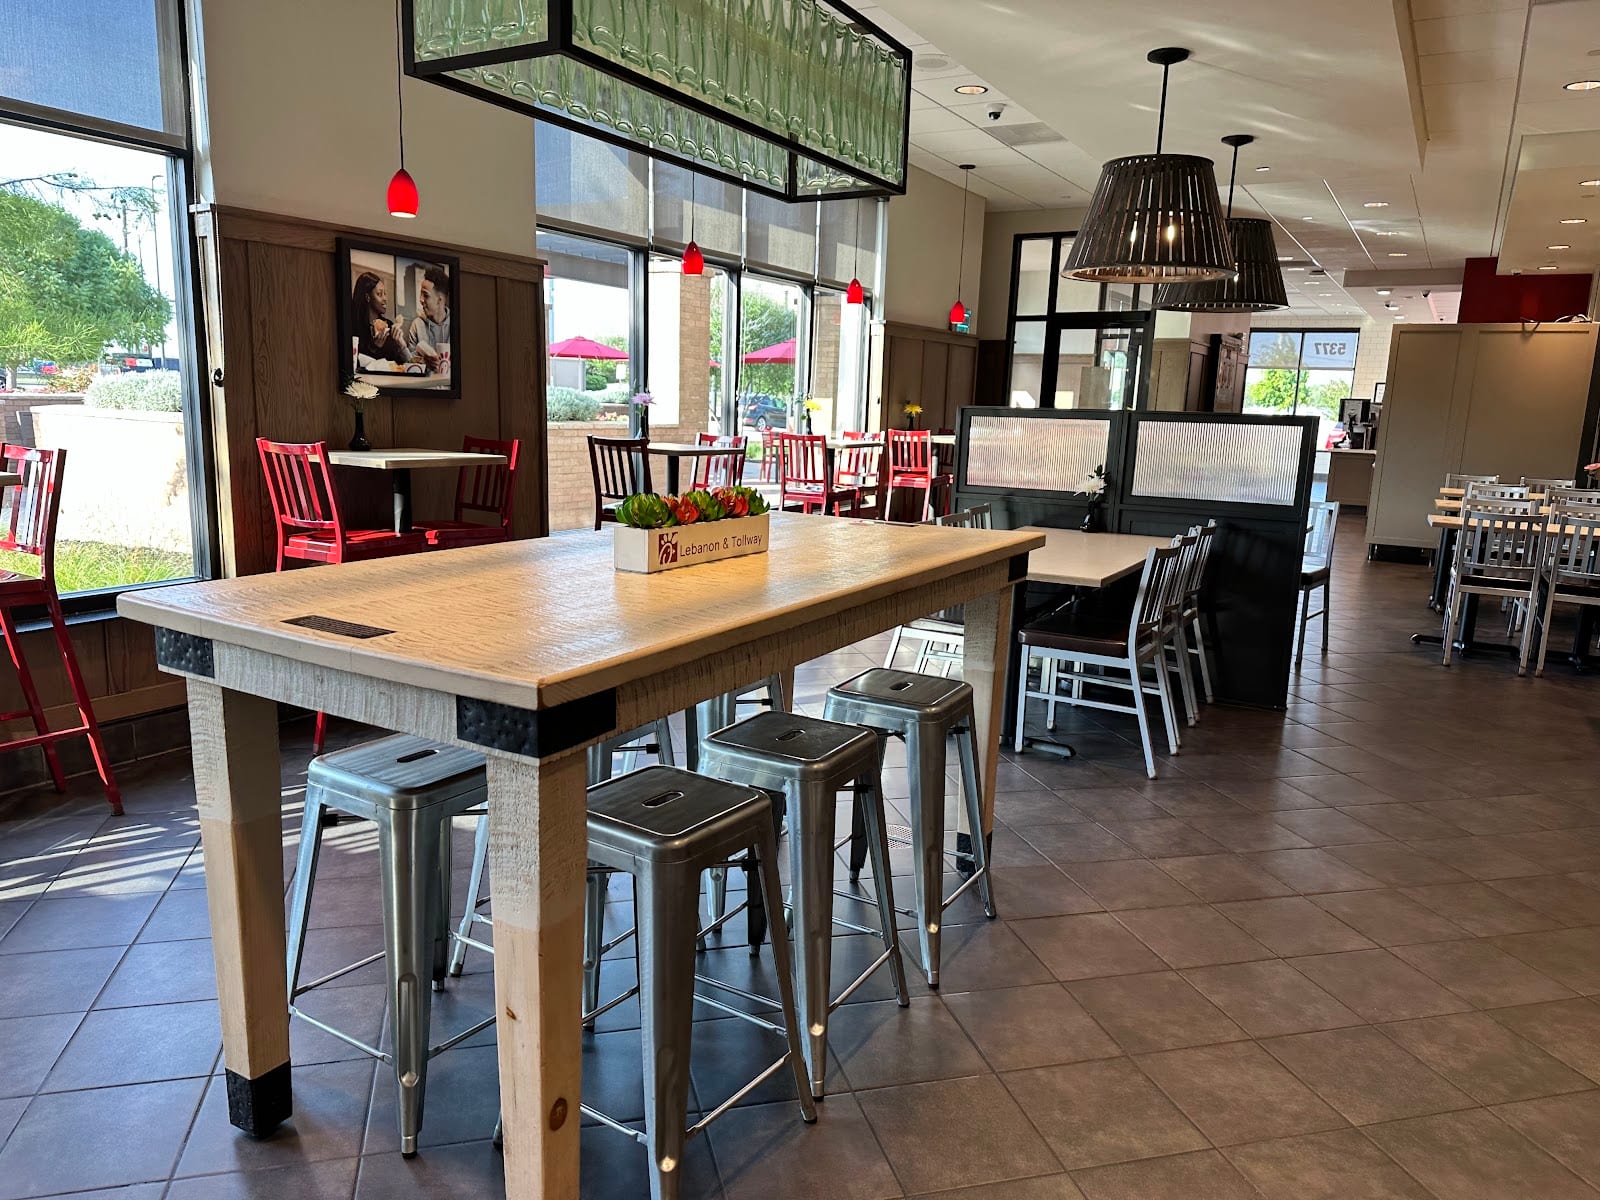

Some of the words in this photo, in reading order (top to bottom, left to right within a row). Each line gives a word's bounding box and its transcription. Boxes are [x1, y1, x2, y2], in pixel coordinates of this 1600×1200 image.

[680, 541, 720, 557] Lebanon
[722, 537, 729, 549] &
[731, 534, 762, 548] Tollway
